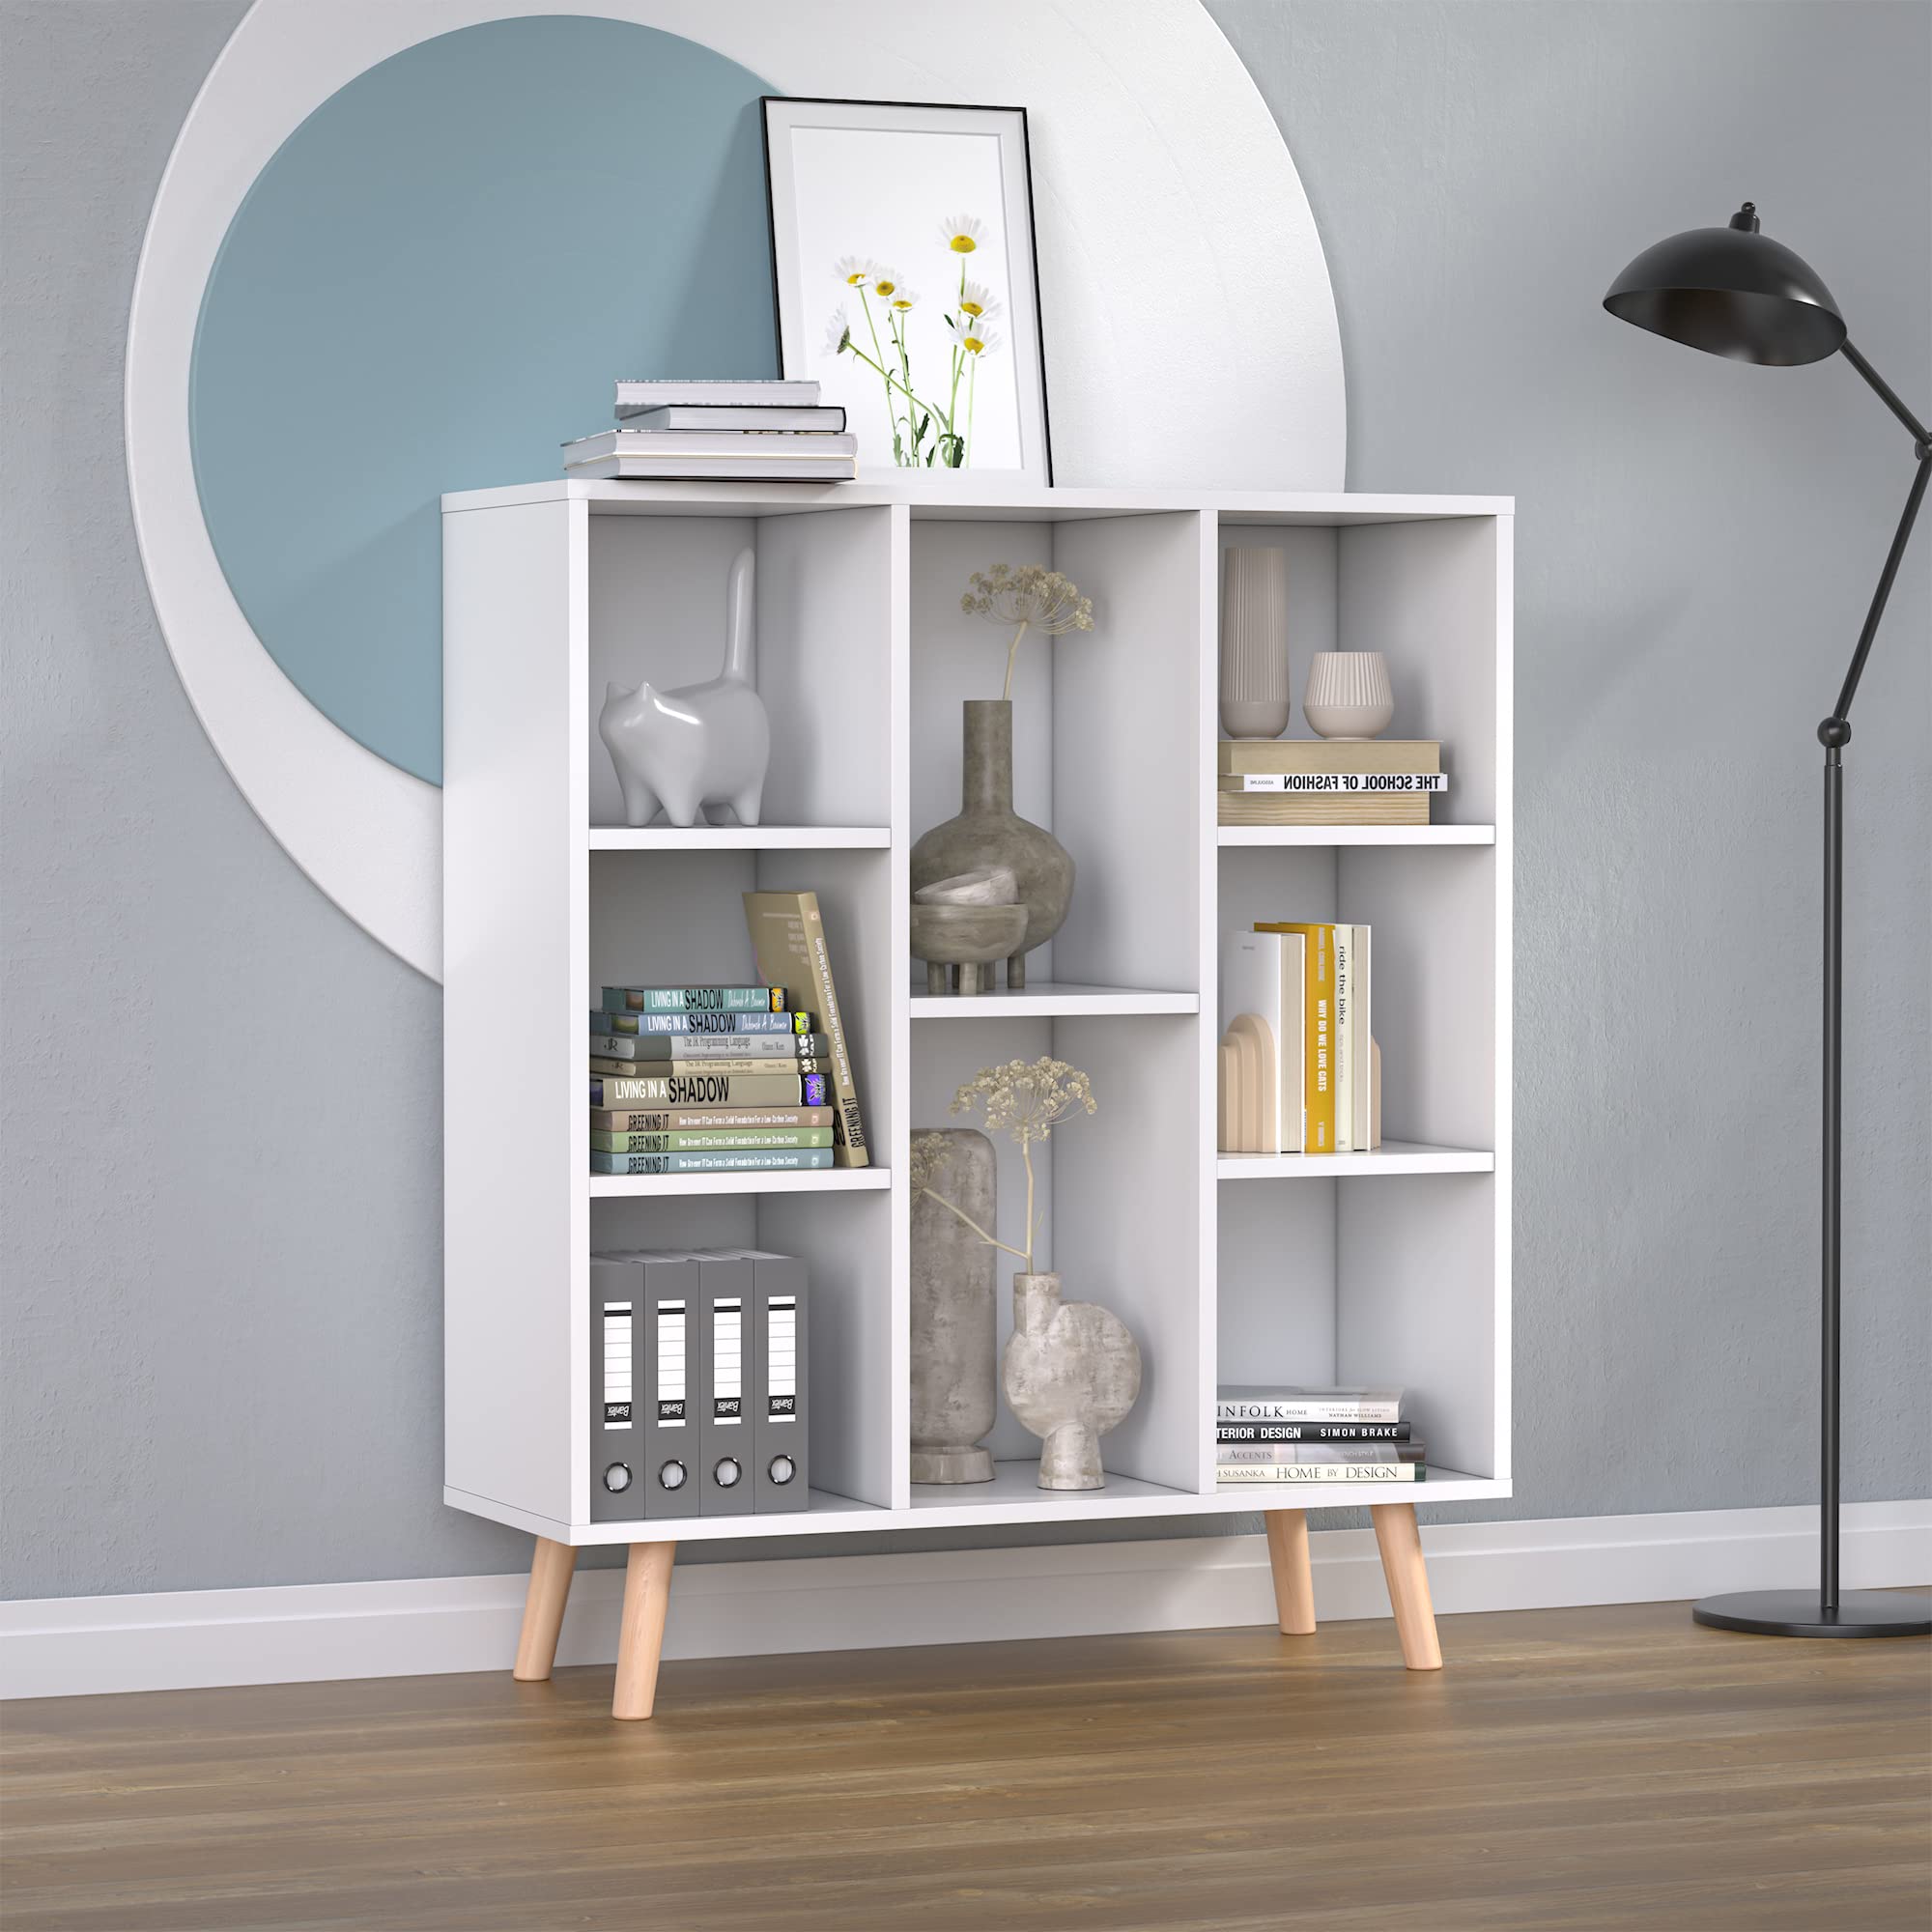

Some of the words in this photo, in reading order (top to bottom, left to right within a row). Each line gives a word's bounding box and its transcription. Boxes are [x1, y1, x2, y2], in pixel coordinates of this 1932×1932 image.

[651, 991, 670, 1008] LIVING
[672, 991, 678, 1007] IN
[679, 991, 684, 1007] A
[685, 990, 724, 1009] SHADOW
[648, 1016, 671, 1032] LIVING
[673, 1015, 680, 1031] IN
[682, 1015, 688, 1031] A
[690, 1014, 735, 1033] SHADOW
[1319, 1021, 1326, 1032] DO
[1319, 1034, 1326, 1047] WE
[615, 1081, 646, 1098] LIVING
[648, 1081, 658, 1097] IN
[660, 1080, 667, 1097] A
[668, 1076, 728, 1102] SHADOW
[628, 1114, 662, 1131] GREENING
[663, 1114, 669, 1129] IT
[844, 1107, 866, 1148] GREENING
[628, 1135, 662, 1151] GREENING
[663, 1135, 669, 1151] IT
[628, 1156, 662, 1174] GREENING
[663, 1156, 669, 1173] IT
[1217, 1406, 1283, 1417] INFOLK
[1261, 1428, 1301, 1438] DESIGN
[1362, 1428, 1398, 1436] BRAKE
[1277, 1467, 1321, 1478] HOME
[1328, 1468, 1338, 1477] BY
[1347, 1466, 1397, 1478] DESIGN
